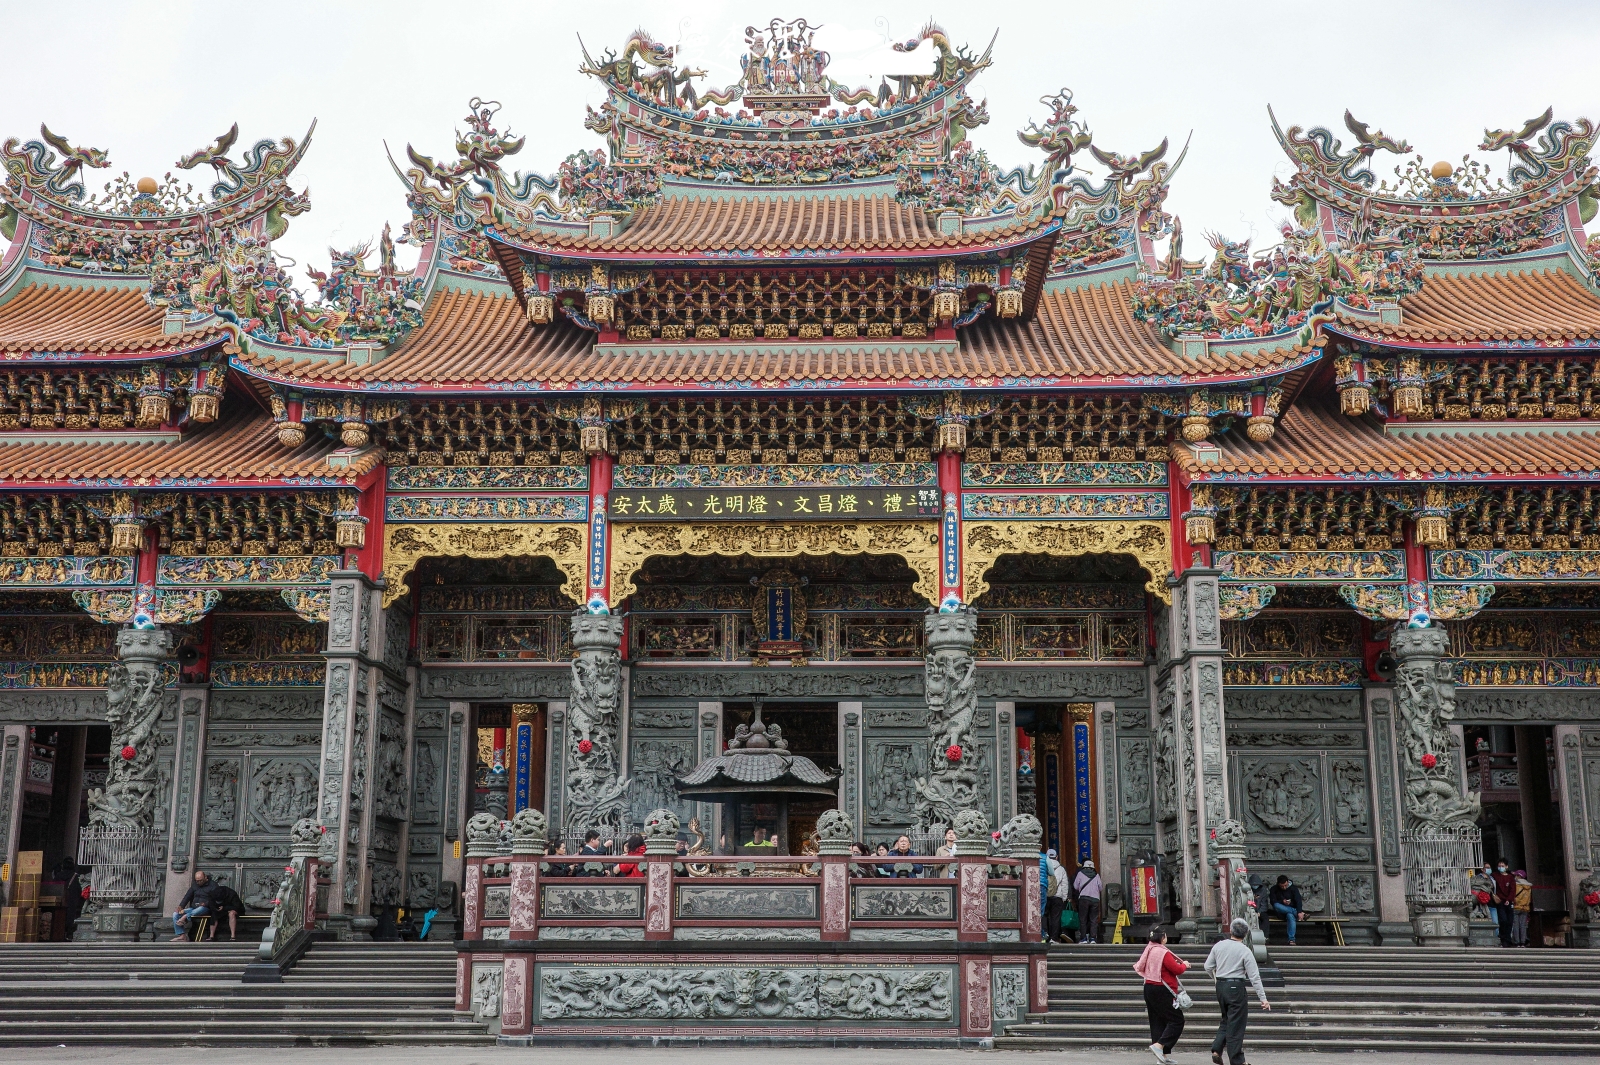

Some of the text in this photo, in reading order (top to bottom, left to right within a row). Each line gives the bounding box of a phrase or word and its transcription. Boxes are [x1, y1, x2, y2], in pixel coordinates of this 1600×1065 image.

[918, 489, 939, 501] 智景
[594, 517, 603, 581] 林口竹林山觀音寺
[947, 515, 956, 580] 林口竹林山觀音寺
[775, 589, 785, 640] 竹林山觀音寺
